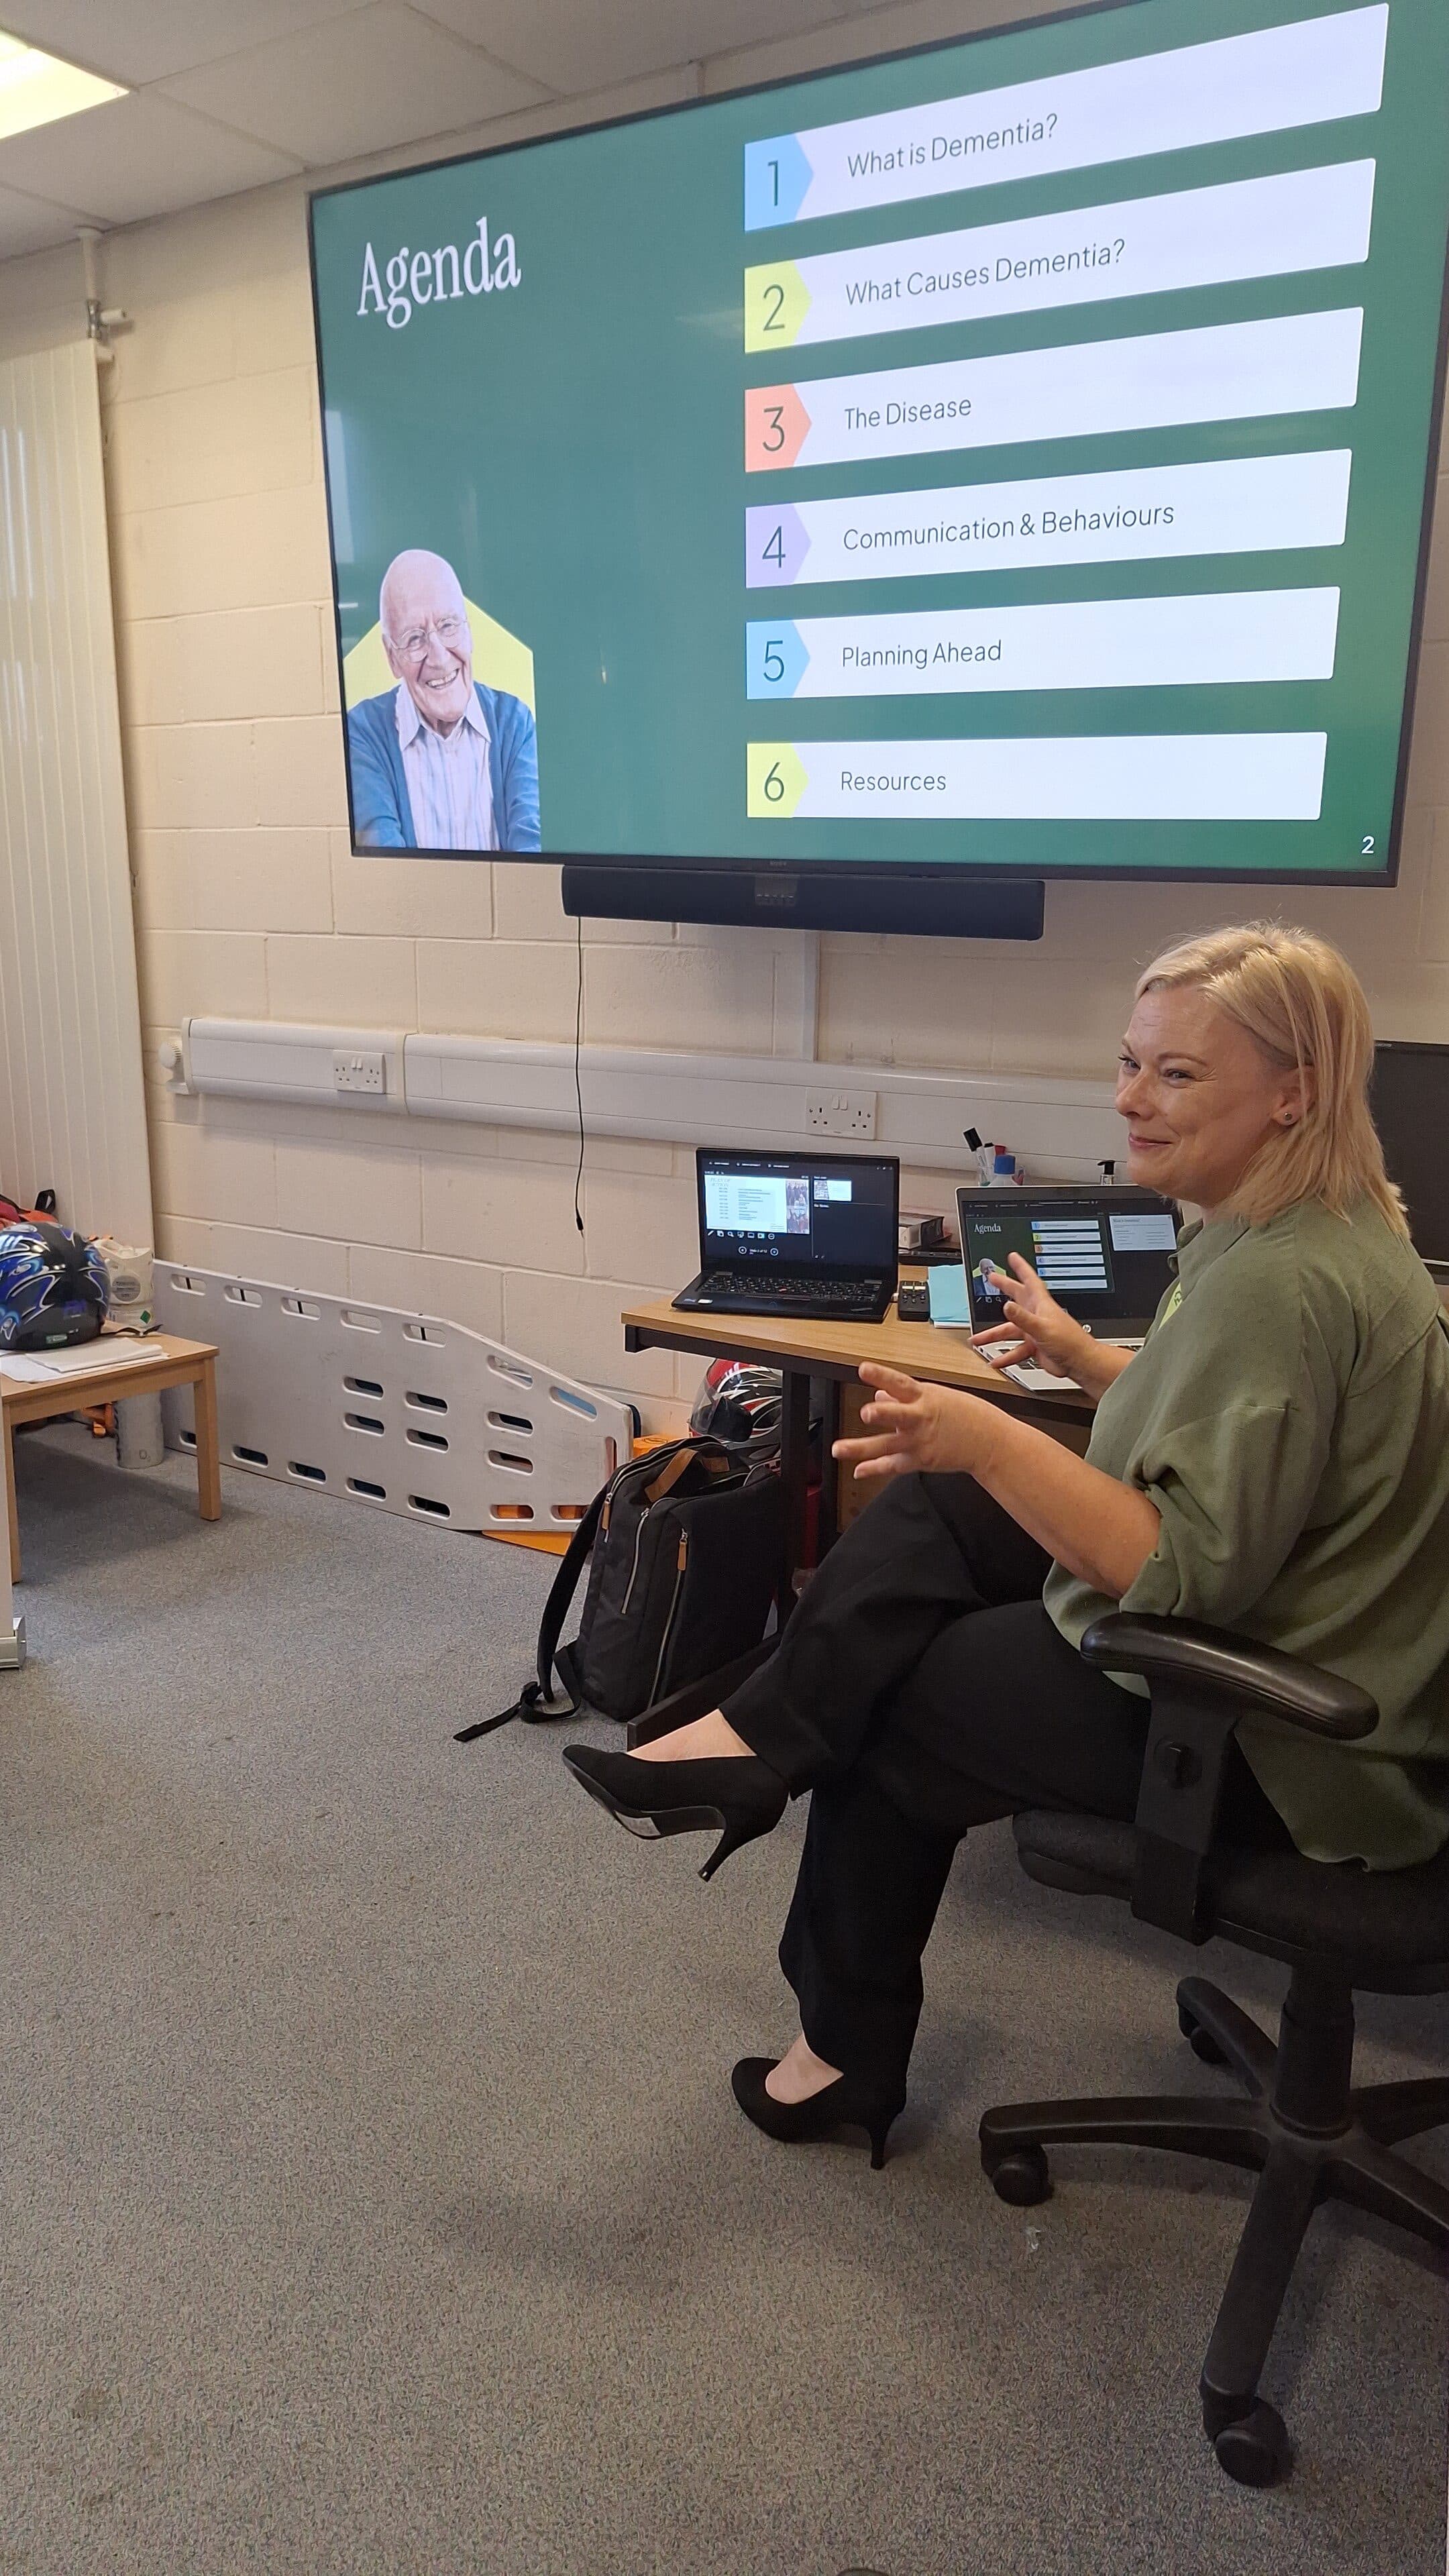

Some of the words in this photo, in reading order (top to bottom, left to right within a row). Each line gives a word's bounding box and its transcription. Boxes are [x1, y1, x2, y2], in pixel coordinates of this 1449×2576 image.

[767, 160, 779, 207] 1
[847, 148, 904, 178] What
[910, 143, 925, 166] is
[932, 113, 1058, 161] Dementia?
[356, 216, 522, 329] Agenda
[763, 284, 785, 331] 2
[846, 278, 901, 305] What
[907, 267, 989, 295] Causes
[996, 238, 1125, 282] Dementia?
[762, 406, 785, 452] 3
[844, 407, 881, 430] The
[886, 399, 971, 425] Disease
[762, 525, 786, 568] 4
[843, 517, 1014, 550] Communication
[1020, 513, 1035, 536] &
[1042, 505, 1174, 534] Behaviours
[763, 640, 785, 682] 5
[843, 644, 928, 670] Planning
[932, 639, 1002, 663] Ahead
[764, 761, 785, 802] 6
[841, 771, 947, 791] Resources
[1361, 835, 1375, 854] 2
[974, 1224, 1002, 1234] Agenda
